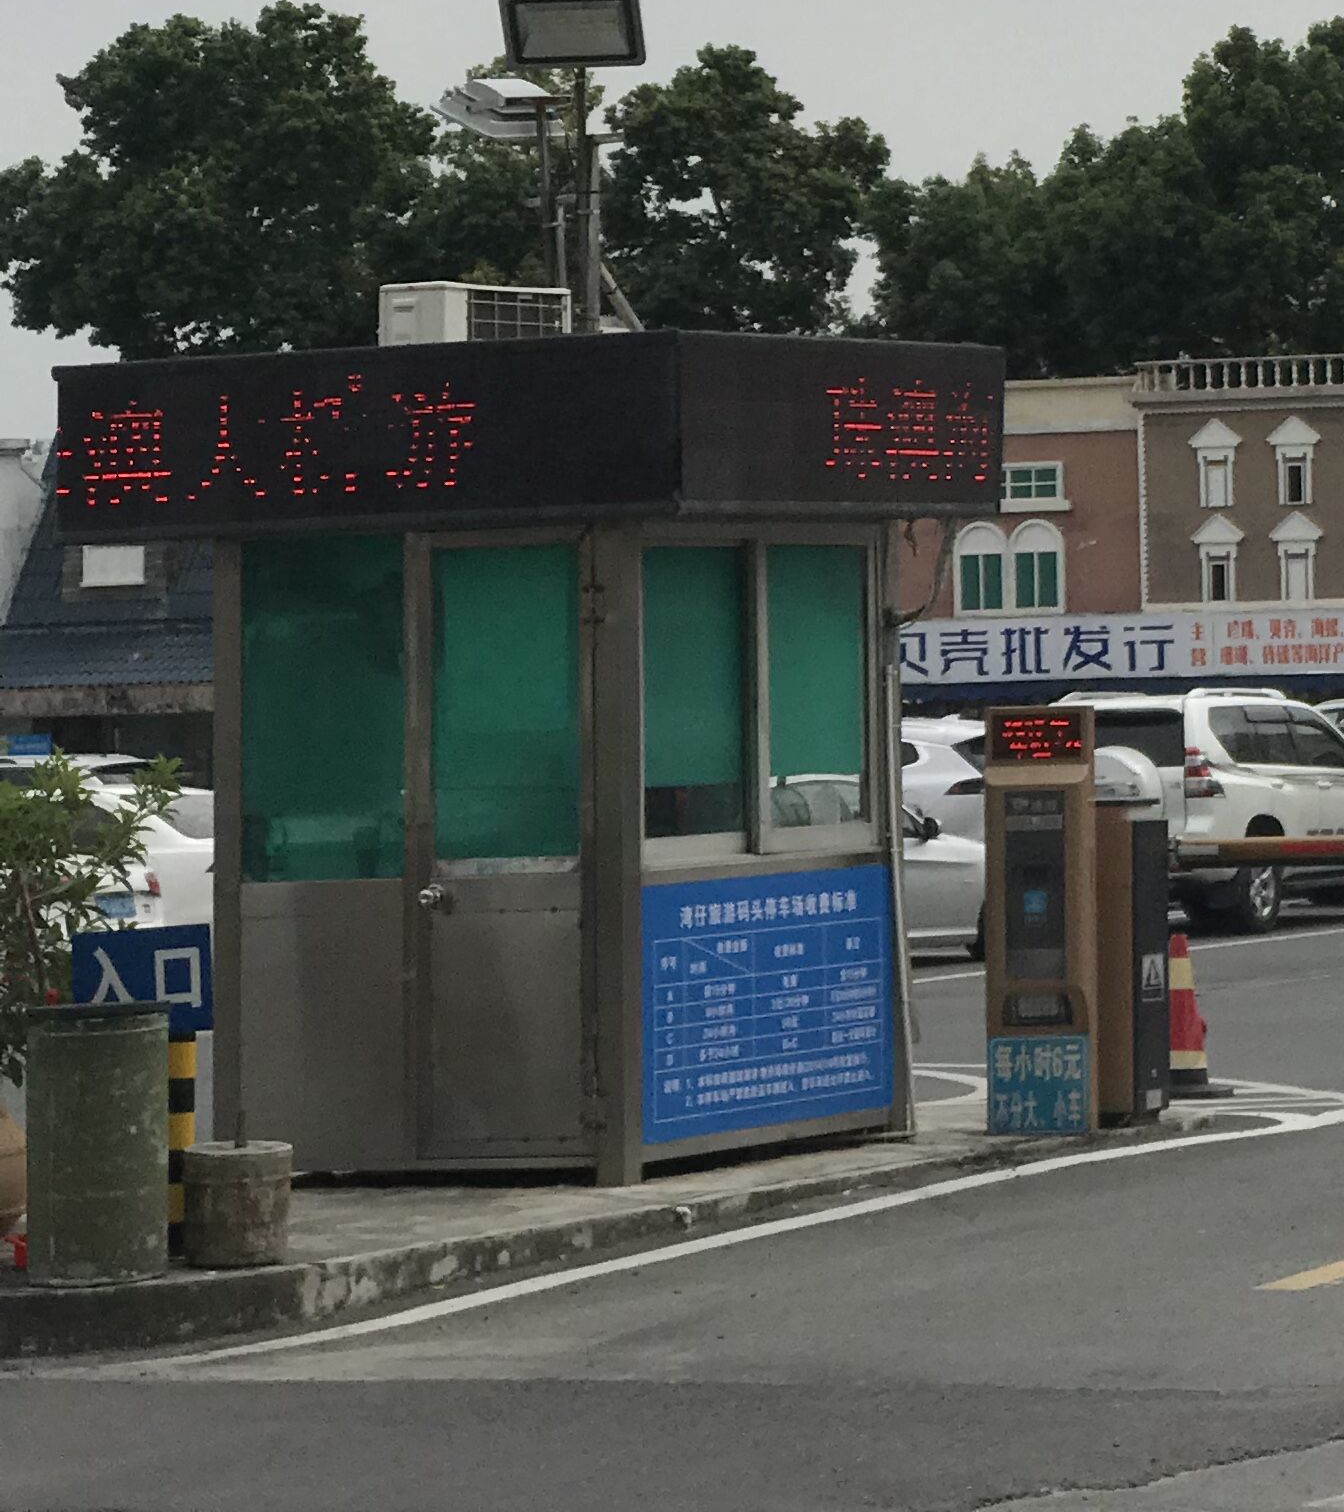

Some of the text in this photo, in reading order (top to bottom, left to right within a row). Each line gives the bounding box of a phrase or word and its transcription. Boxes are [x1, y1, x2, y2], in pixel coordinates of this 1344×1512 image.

[900, 625, 1175, 676] 贝壳批发行
[91, 946, 202, 1008] 入口
